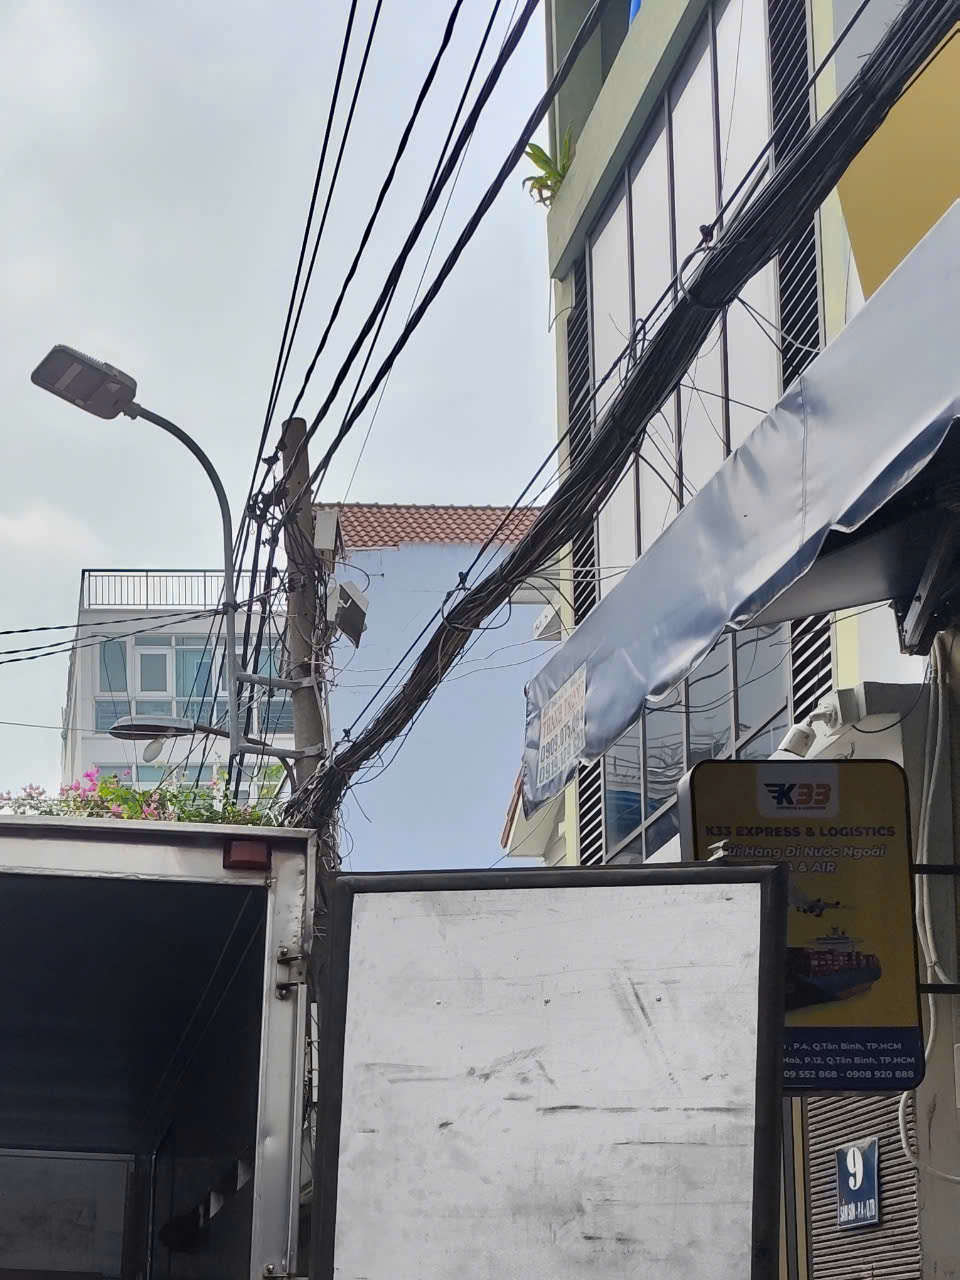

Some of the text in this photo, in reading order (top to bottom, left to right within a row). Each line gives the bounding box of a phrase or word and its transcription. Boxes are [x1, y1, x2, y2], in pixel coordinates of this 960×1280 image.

[764, 783, 831, 806] K33
[705, 826, 896, 837] K33 EXPRESS & LOGISTICS
[799, 862, 809, 873] &
[811, 862, 837, 873] AIR
[866, 1042, 902, 1050] TP.HCM
[880, 1056, 915, 1064] TP.HCM
[798, 1070, 816, 1078] 552
[818, 1070, 838, 1078] 868
[846, 1070, 872, 1078] 0908
[874, 1070, 893, 1078] 920
[895, 1070, 914, 1078] 888
[846, 1146, 864, 1191] 9
